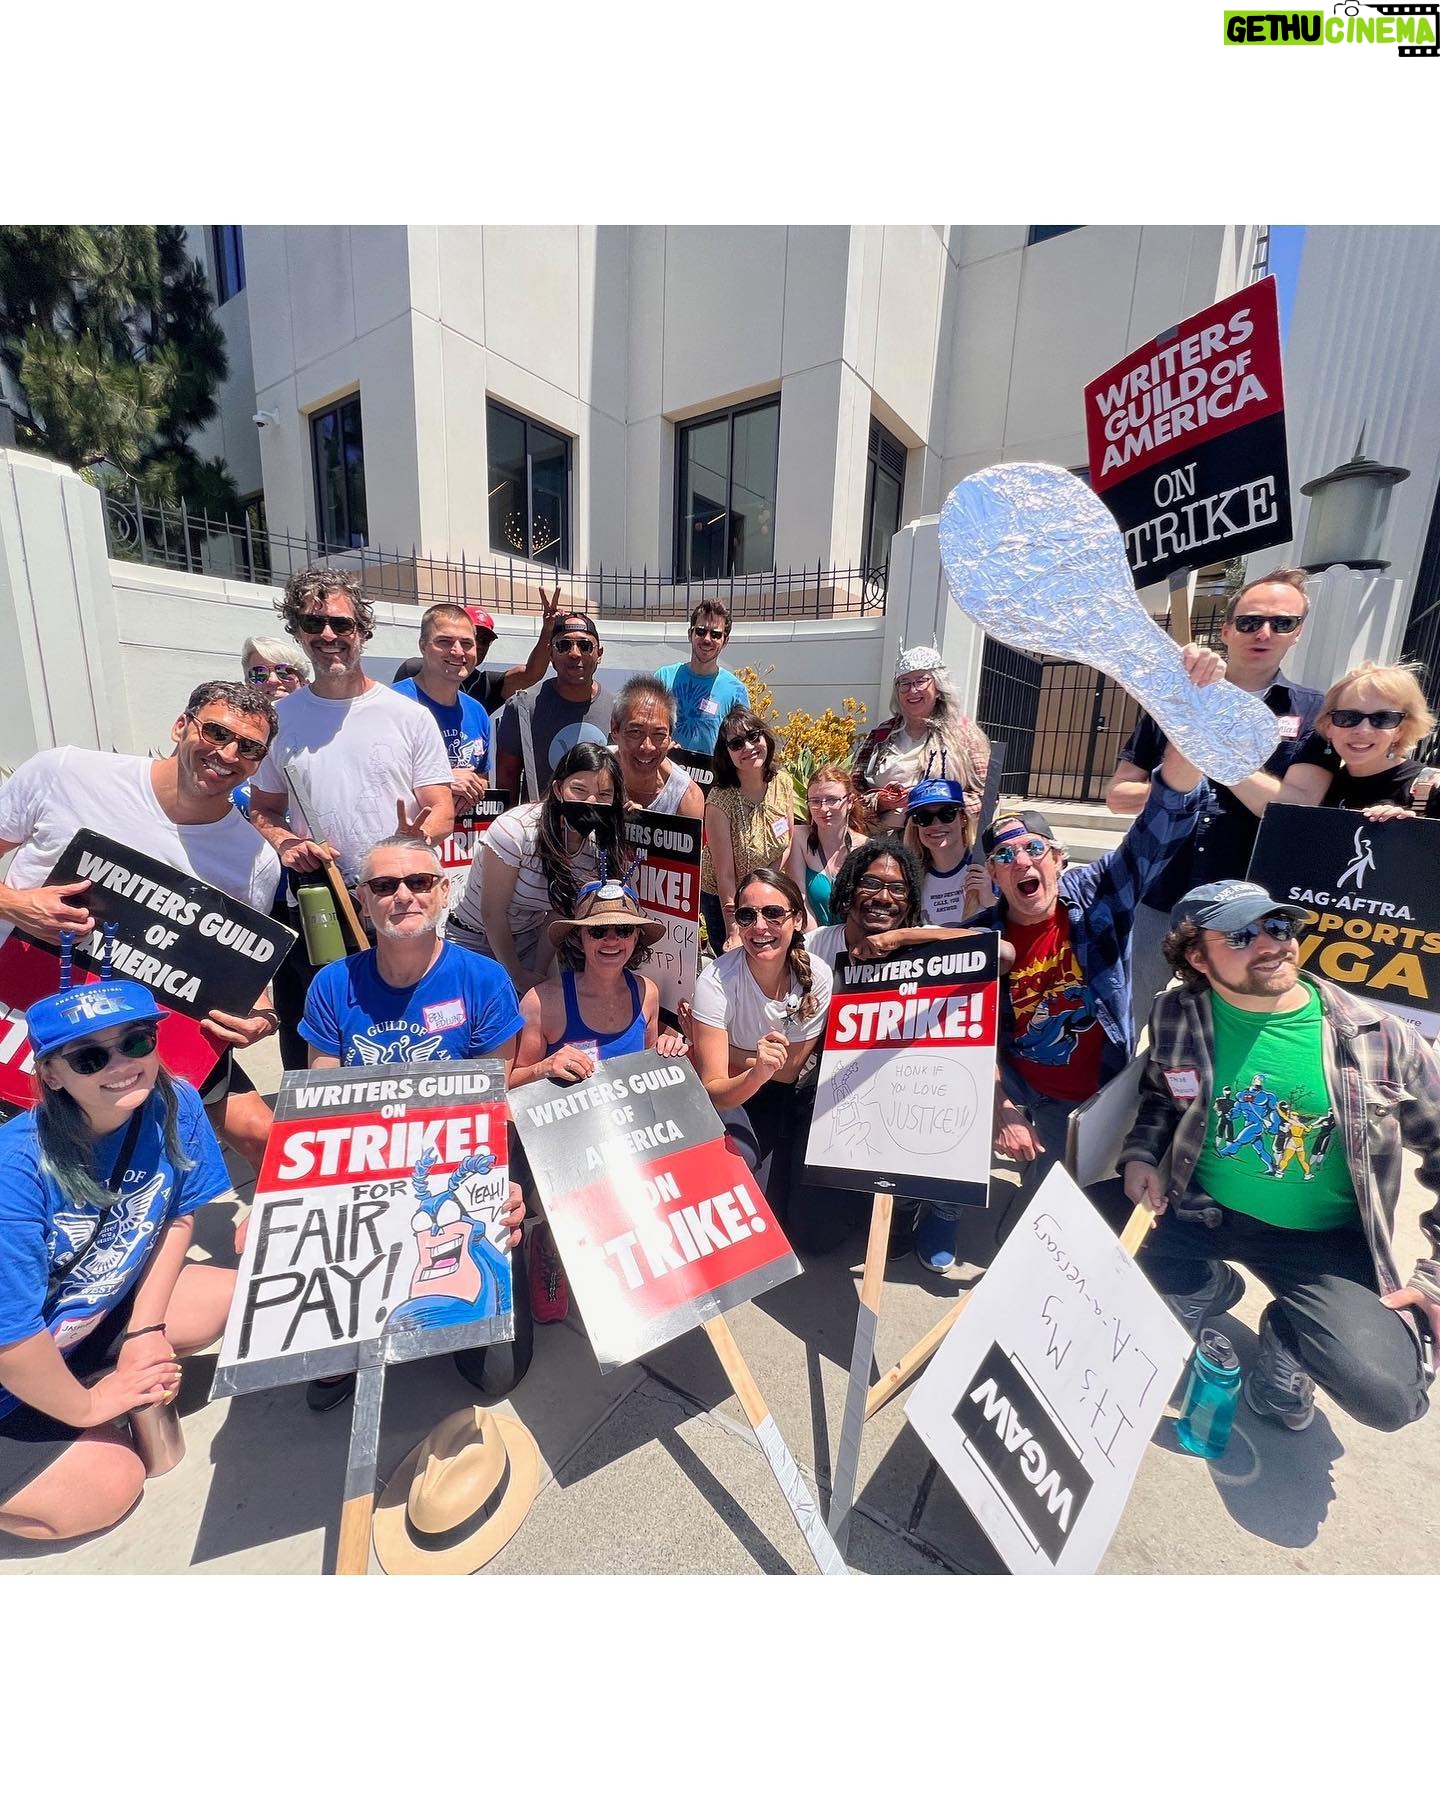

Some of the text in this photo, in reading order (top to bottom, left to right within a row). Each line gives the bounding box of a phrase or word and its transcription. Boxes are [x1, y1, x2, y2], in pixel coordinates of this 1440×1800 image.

[1095, 308, 1254, 418] WRITERS
[1104, 350, 1252, 442] GUILD OF
[1100, 373, 1268, 477] AMERICA
[1154, 463, 1197, 508] ON
[1125, 475, 1278, 571] TRIKE
[476, 801, 504, 815] GUILD
[625, 823, 693, 853] TERS GUILD
[76, 851, 275, 963] WRITERS GUILD
[145, 925, 180, 951] OF
[1303, 910, 1440, 954] PPORTS
[76, 930, 201, 1003] AMERICA
[844, 951, 987, 985] WRITERS GUILD
[61, 997, 134, 1025] TICK
[899, 982, 918, 996] ON
[367, 1020, 428, 1037] GUILD OF
[834, 993, 984, 1043] STRIKE!
[295, 1074, 491, 1109] WRITERS GUILD
[896, 1064, 944, 1077] HONK IF
[914, 1082, 947, 1096] LOVE
[381, 1103, 406, 1119] ON
[526, 1066, 687, 1128] WRITERS GUILD
[612, 1105, 634, 1127] OF
[278, 1114, 491, 1180] STRIKE!
[585, 1119, 685, 1171] AERICA
[123, 1170, 147, 1183] OF
[353, 1180, 408, 1201] FOR
[465, 1177, 504, 1205] YEAH!
[251, 1198, 390, 1276] FAIR
[604, 1184, 767, 1290] TRIKE!
[237, 1242, 403, 1360] PAY!
[970, 1378, 1076, 1533] WGAW
